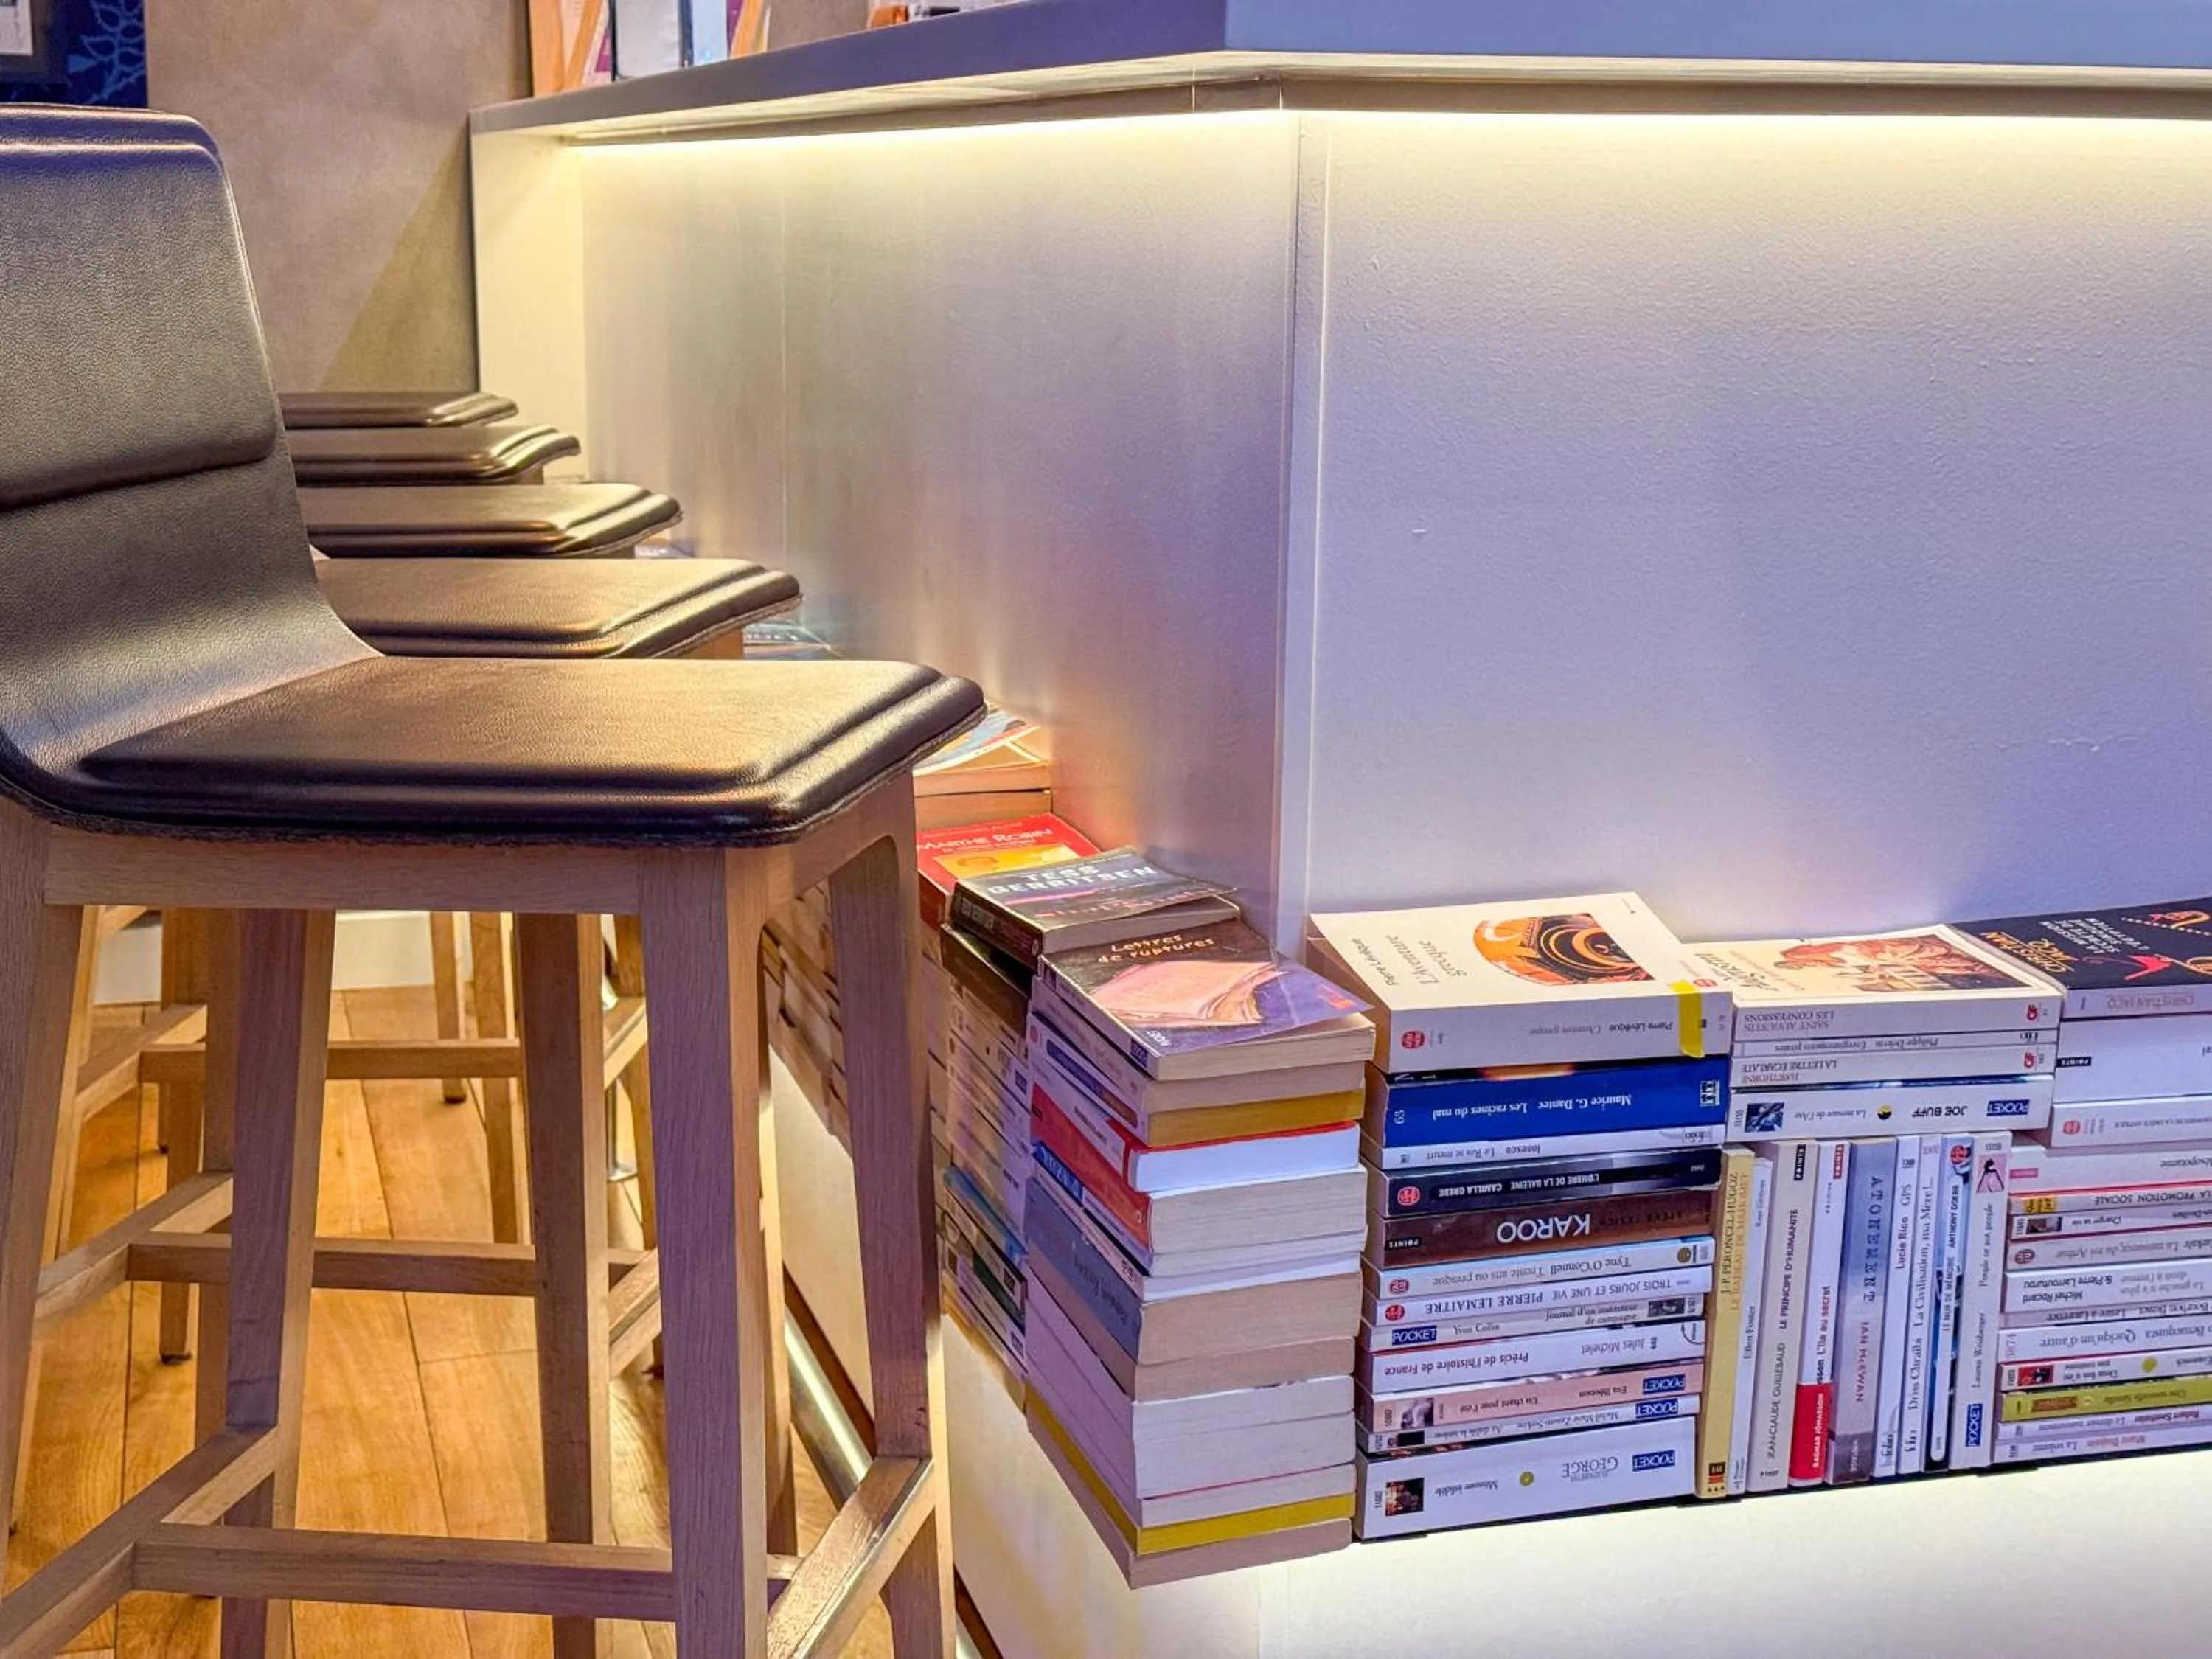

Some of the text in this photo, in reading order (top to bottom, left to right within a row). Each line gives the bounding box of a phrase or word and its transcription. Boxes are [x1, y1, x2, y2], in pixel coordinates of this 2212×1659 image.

[992, 827, 1053, 844] ROBIN
[987, 866, 1158, 894] GERRITSEN
[1098, 936, 1216, 964] de ruptures
[1111, 933, 1183, 953] Lettres
[1647, 1020, 1674, 1032] Pierre
[1743, 1011, 1814, 1023] CONFESSIONS
[1432, 1093, 1632, 1121] Maurice G. Dantec Les racines du mal
[1912, 1106, 1942, 1119] BUFF
[1944, 1105, 1968, 1117] JOE
[1986, 1099, 2030, 1116] POCKET
[1484, 1147, 1495, 1157] Le
[1505, 1144, 1541, 1155] Ionesco
[1439, 1172, 1600, 1198] L'OMBRE DE LA BALEINE CAMILLA GREBE
[1900, 1183, 1912, 1207] GPS
[2093, 1194, 2134, 1206] SOCIALE
[2136, 1191, 2195, 1204] PROMOTION
[1495, 1211, 1591, 1244] KAROO
[1896, 1215, 1909, 1239] Rico
[1983, 1202, 1994, 1231] people
[1947, 1212, 1958, 1248] ANTHONY
[1894, 1241, 1907, 1269] Lucie
[1432, 1254, 1632, 1286] Tyne O'Connell Trente ans ou presque
[1978, 1259, 1991, 1287] People
[1854, 1175, 1885, 1403] ATONEMENT IAN McEWAN
[2077, 1276, 2103, 1287] Pierre
[1425, 1277, 1672, 1315] TROIS JOURS ET UNE VIE PIERRE LEMAITRE
[1779, 1273, 1792, 1318] PRINCIPE
[1821, 1285, 1831, 1318] secret
[2022, 1290, 2083, 1304] Michel Rocard
[1545, 1308, 1576, 1322] Journal
[1778, 1318, 1788, 1330] LE
[1907, 1381, 1919, 1411] Driss
[1913, 1311, 1924, 1327] La
[1921, 1222, 1931, 1241] ma
[1391, 1327, 1437, 1345] POCKET
[2039, 1336, 2079, 1349] d'autre
[2080, 1328, 2137, 1346] Quelqu'un
[1384, 1338, 1646, 1377] Jules Michelet Précis de l'histoire de France
[1642, 1373, 1686, 1394] POCKET
[1481, 1398, 1500, 1411] pour
[1525, 1396, 1539, 1405] Un
[1635, 1397, 1678, 1419] POCKET
[1966, 1403, 1983, 1447] POCKET
[1560, 1456, 1618, 1478] GEORGE
[1632, 1449, 1675, 1472] POCKET
